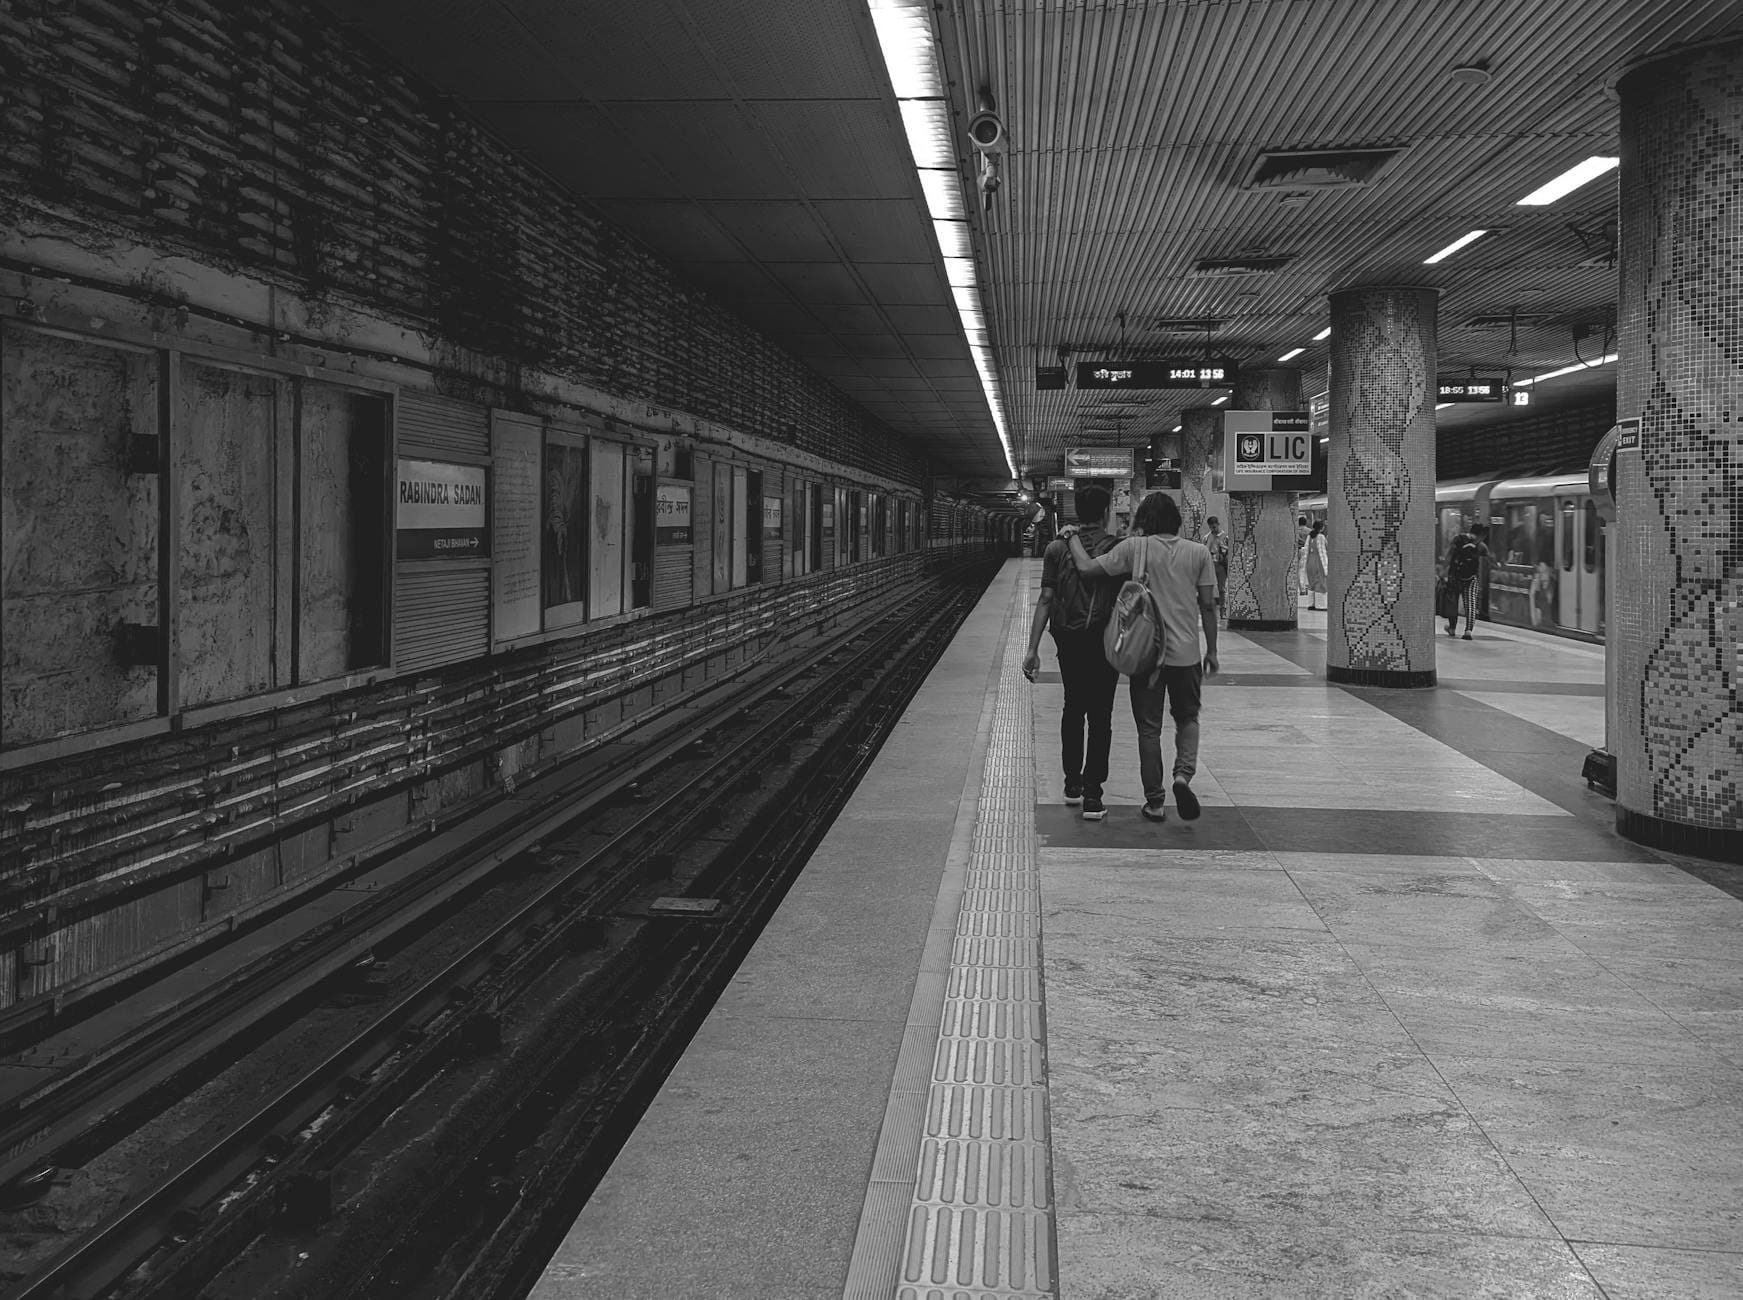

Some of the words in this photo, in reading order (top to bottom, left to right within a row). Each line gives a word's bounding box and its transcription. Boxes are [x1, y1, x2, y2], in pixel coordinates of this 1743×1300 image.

[1170, 369, 1196, 379] 14:01
[1270, 436, 1305, 460] LIC
[400, 480, 449, 504] RABINDRA
[454, 483, 480, 504] SADAN
